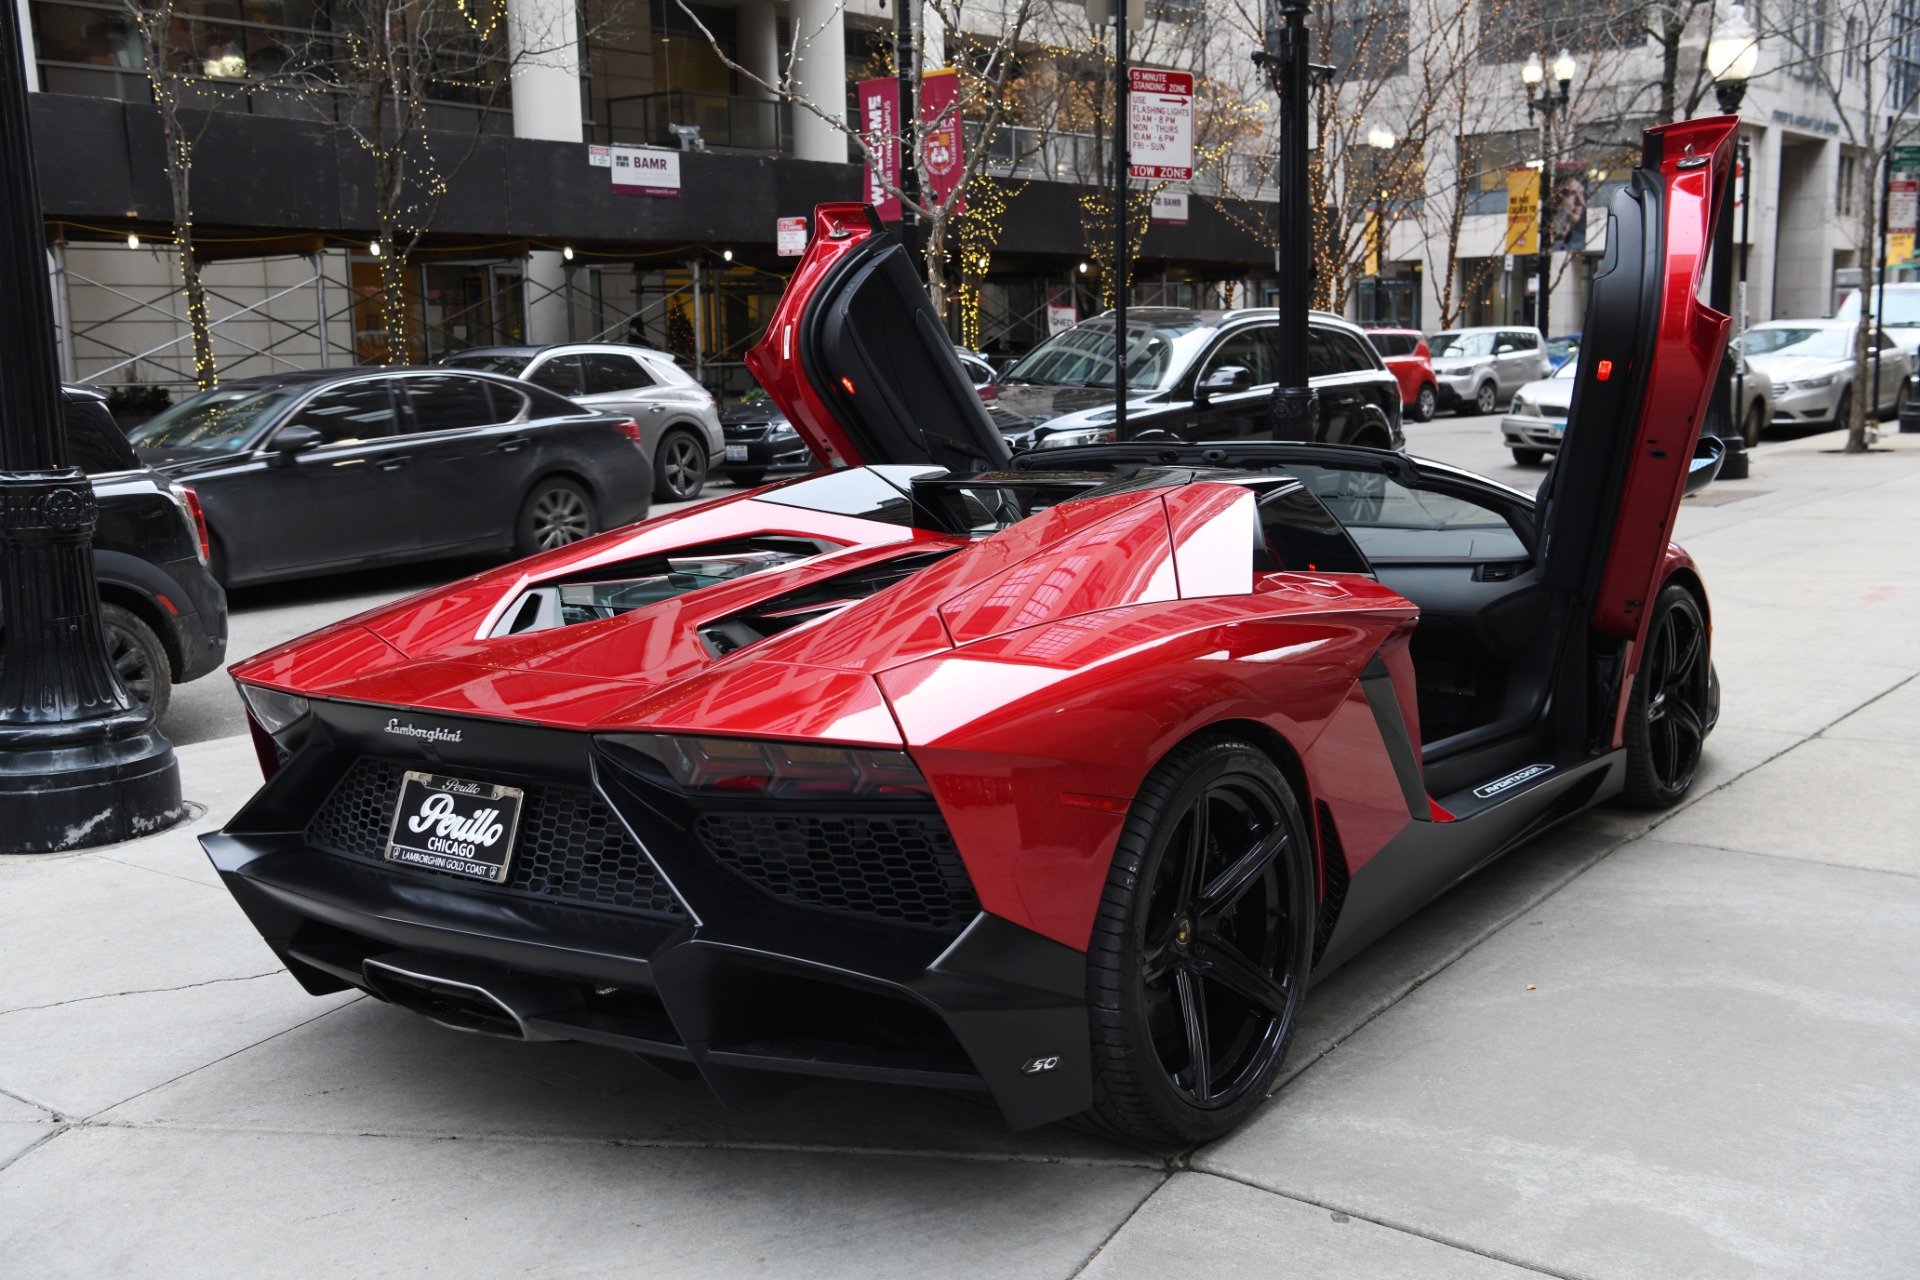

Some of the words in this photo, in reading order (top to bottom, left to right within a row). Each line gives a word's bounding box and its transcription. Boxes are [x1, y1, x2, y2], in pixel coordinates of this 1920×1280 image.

[1133, 71, 1140, 80] 15
[1142, 72, 1167, 83] MINUTE
[1133, 81, 1166, 92] STANDING
[1169, 84, 1187, 93] ZONE
[1133, 96, 1146, 104] USE
[1133, 105, 1165, 115] FLASHING
[1167, 108, 1190, 117] LIGHTS
[1133, 114, 1140, 122] 10
[1142, 115, 1152, 123] AM
[1159, 116, 1163, 124] 8
[1156, 125, 1179, 134] THURS
[1133, 132, 1140, 140] 10
[1141, 133, 1151, 141] AM
[1150, 143, 1165, 151] SUN
[634, 156, 667, 170] BAMR
[1133, 166, 1155, 177] TOW
[1160, 167, 1187, 179] ZONE
[384, 717, 463, 743] Lamborghini
[442, 778, 480, 795] Perillo
[408, 793, 503, 847] Perillo
[427, 836, 475, 858] CHICAGO
[401, 850, 446, 868] LAMBORGHINI
[446, 859, 465, 871] GOLD
[465, 863, 487, 876] COAST
